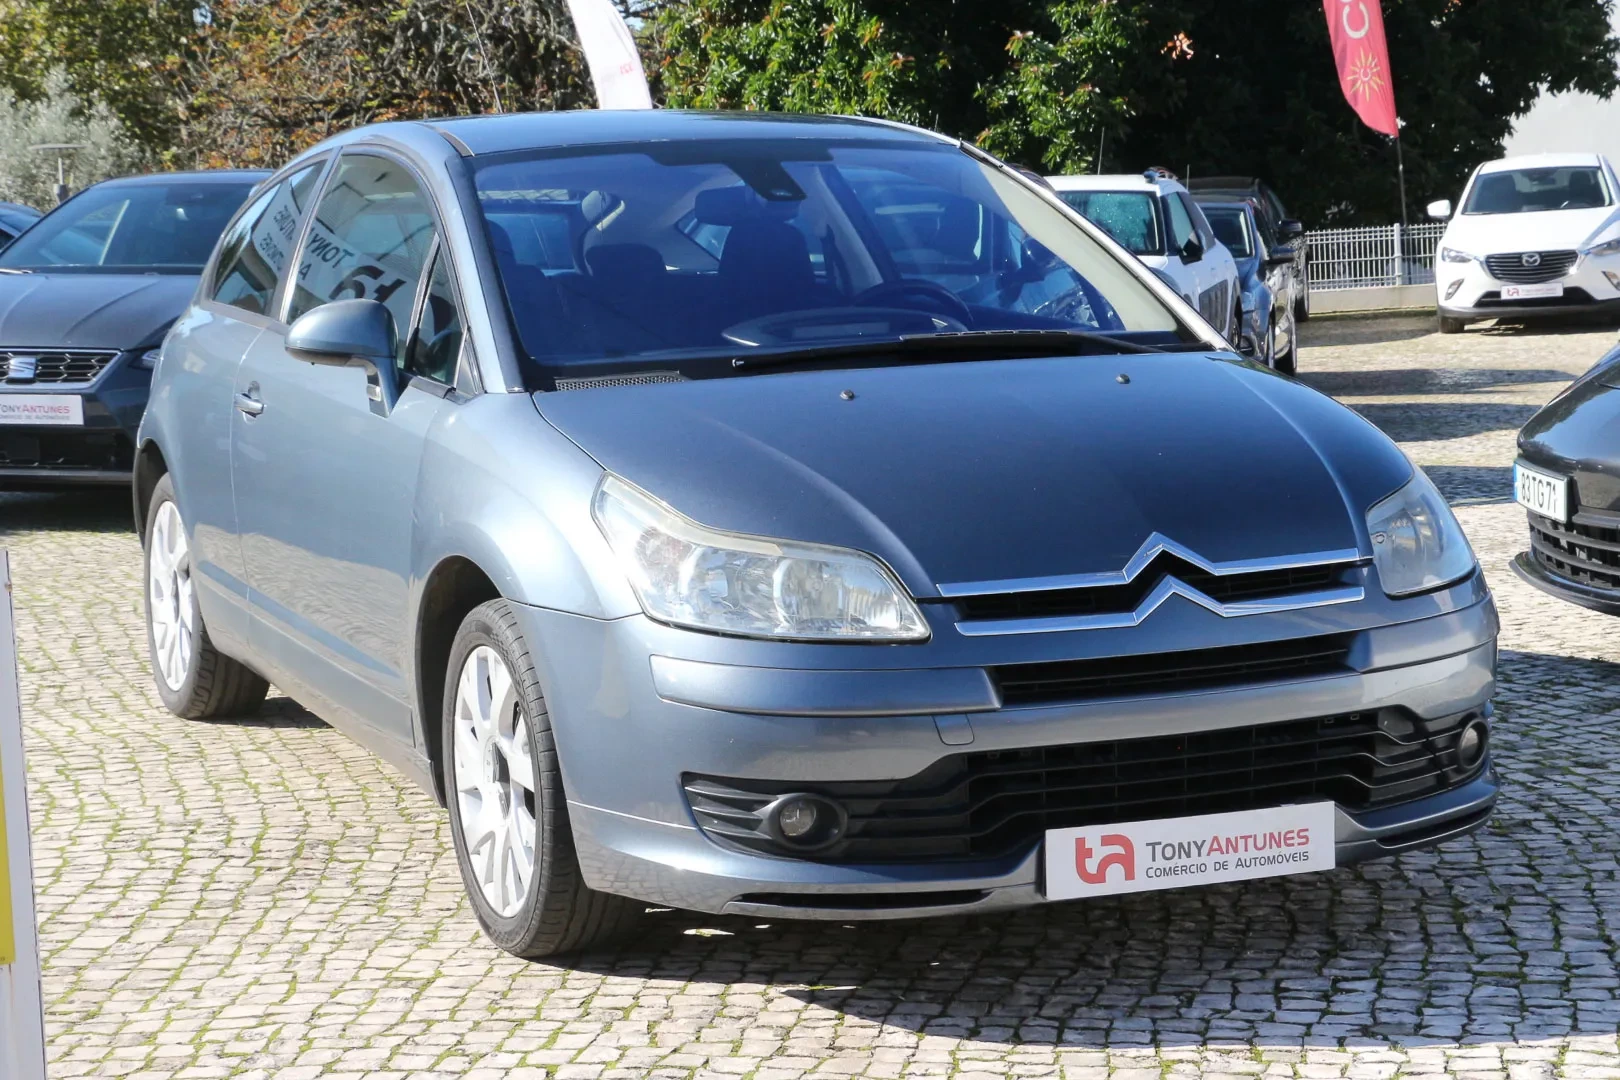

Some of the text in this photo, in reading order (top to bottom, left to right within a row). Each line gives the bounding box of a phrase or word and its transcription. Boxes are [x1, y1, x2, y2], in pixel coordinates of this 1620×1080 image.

[1521, 472, 1557, 514] 83TG71
[1145, 851, 1310, 879] COMÉRCIO DE AUTOMÓVEIS
